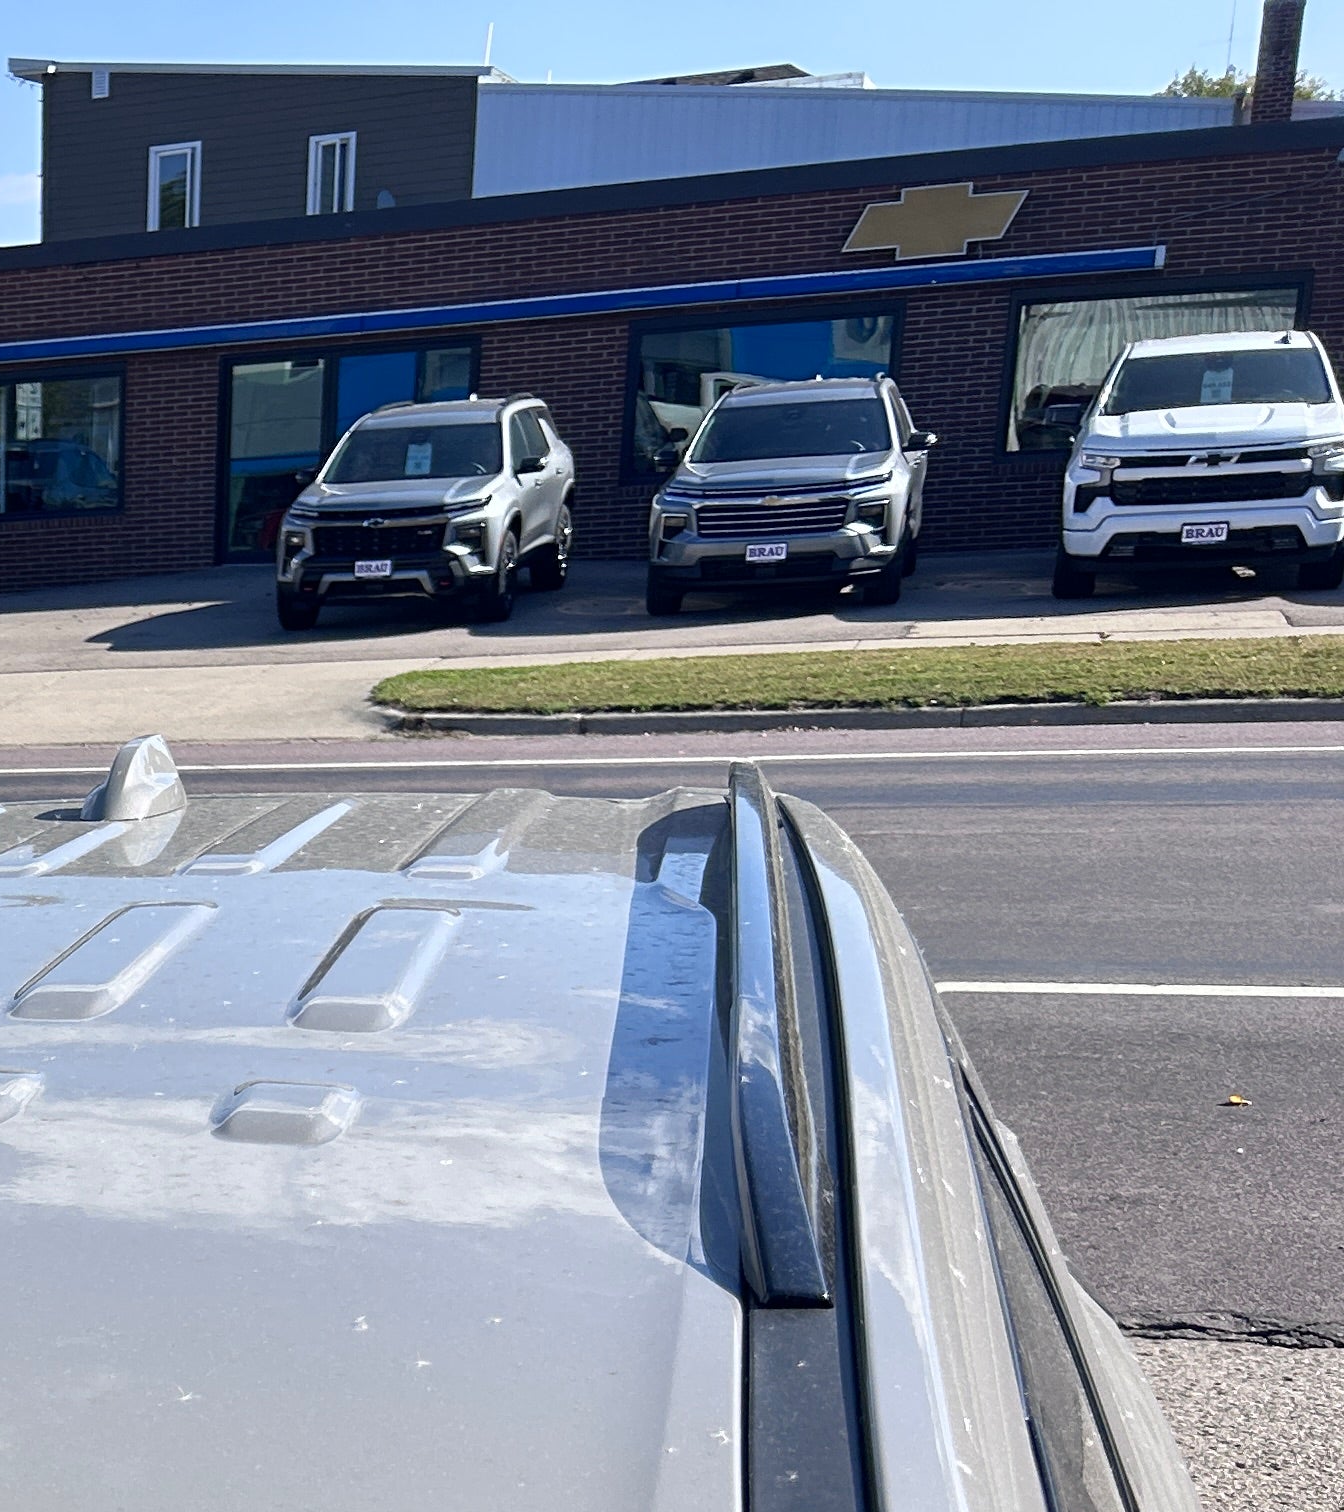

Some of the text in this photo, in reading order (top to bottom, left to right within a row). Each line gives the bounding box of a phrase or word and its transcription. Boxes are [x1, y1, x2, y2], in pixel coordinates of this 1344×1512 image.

[1185, 527, 1225, 539] BRAU
[749, 546, 784, 558] BRAU
[356, 563, 389, 574] BRAU
